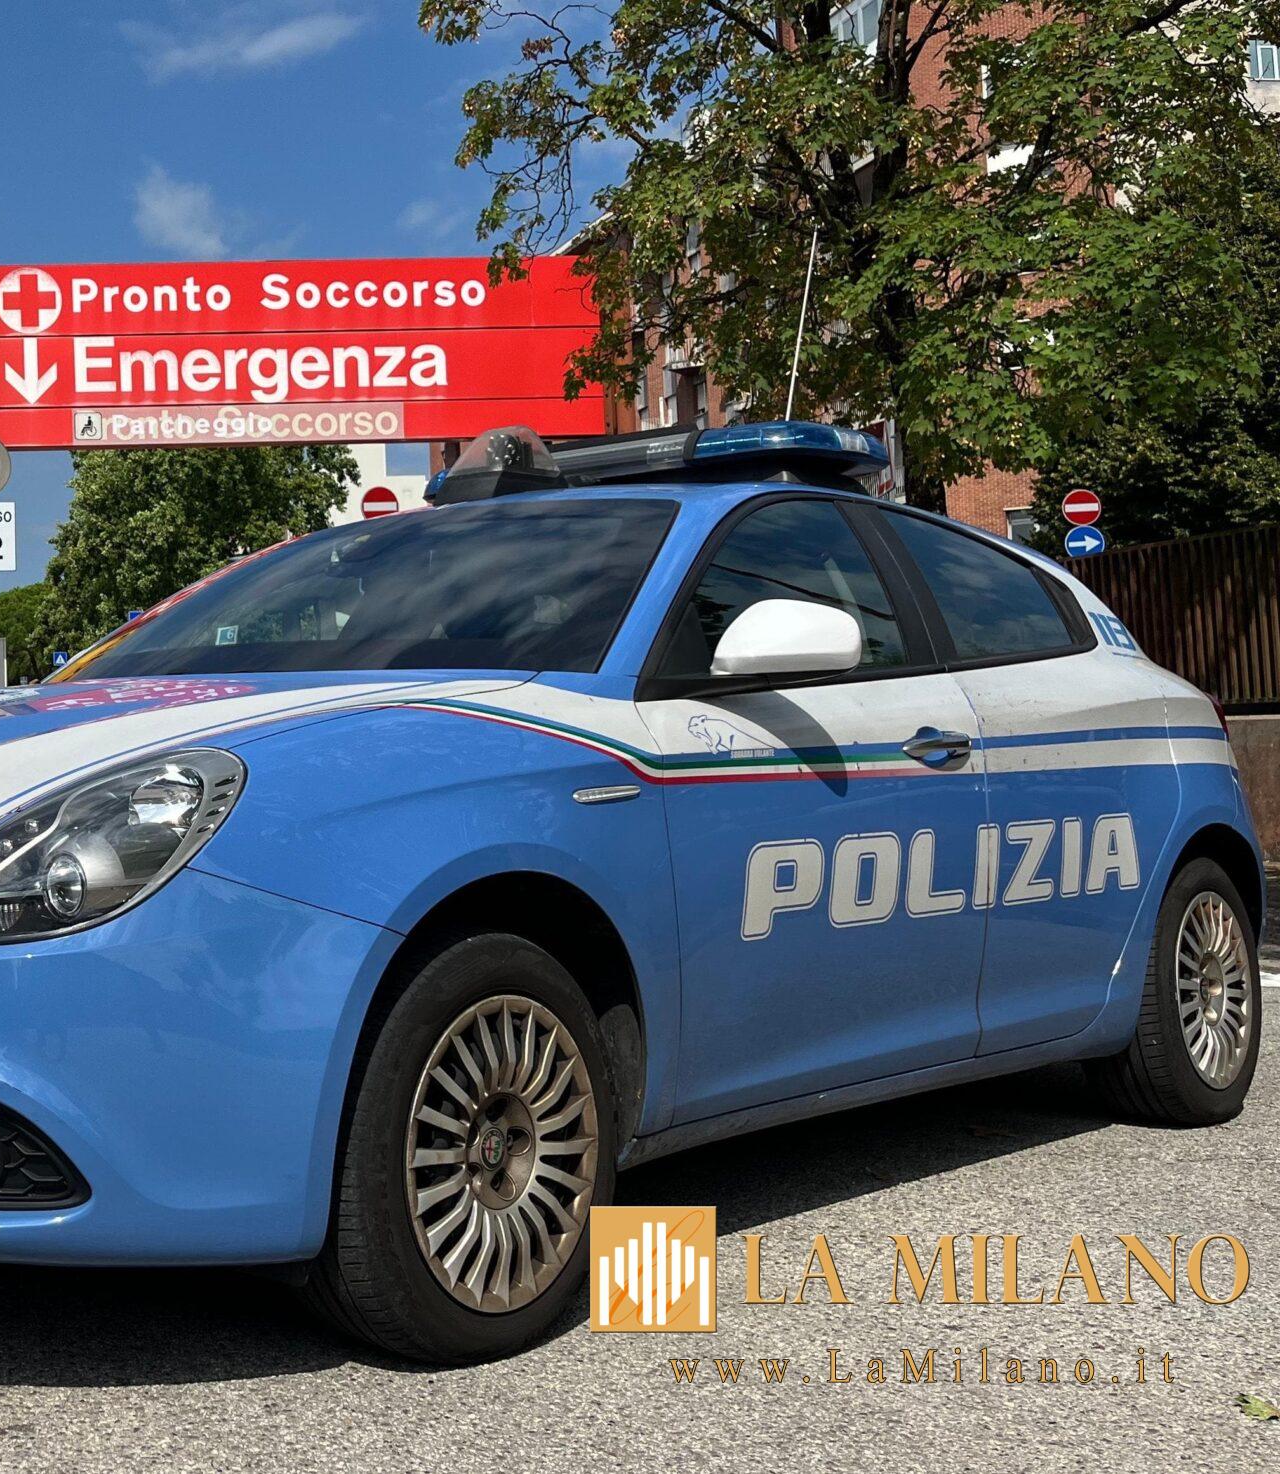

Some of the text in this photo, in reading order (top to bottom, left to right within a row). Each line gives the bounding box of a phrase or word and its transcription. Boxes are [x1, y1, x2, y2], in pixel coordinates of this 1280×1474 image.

[71, 273, 486, 313] Pronto Soccorso
[73, 336, 448, 403] Emergenza
[739, 812, 1140, 943] POLIZIA
